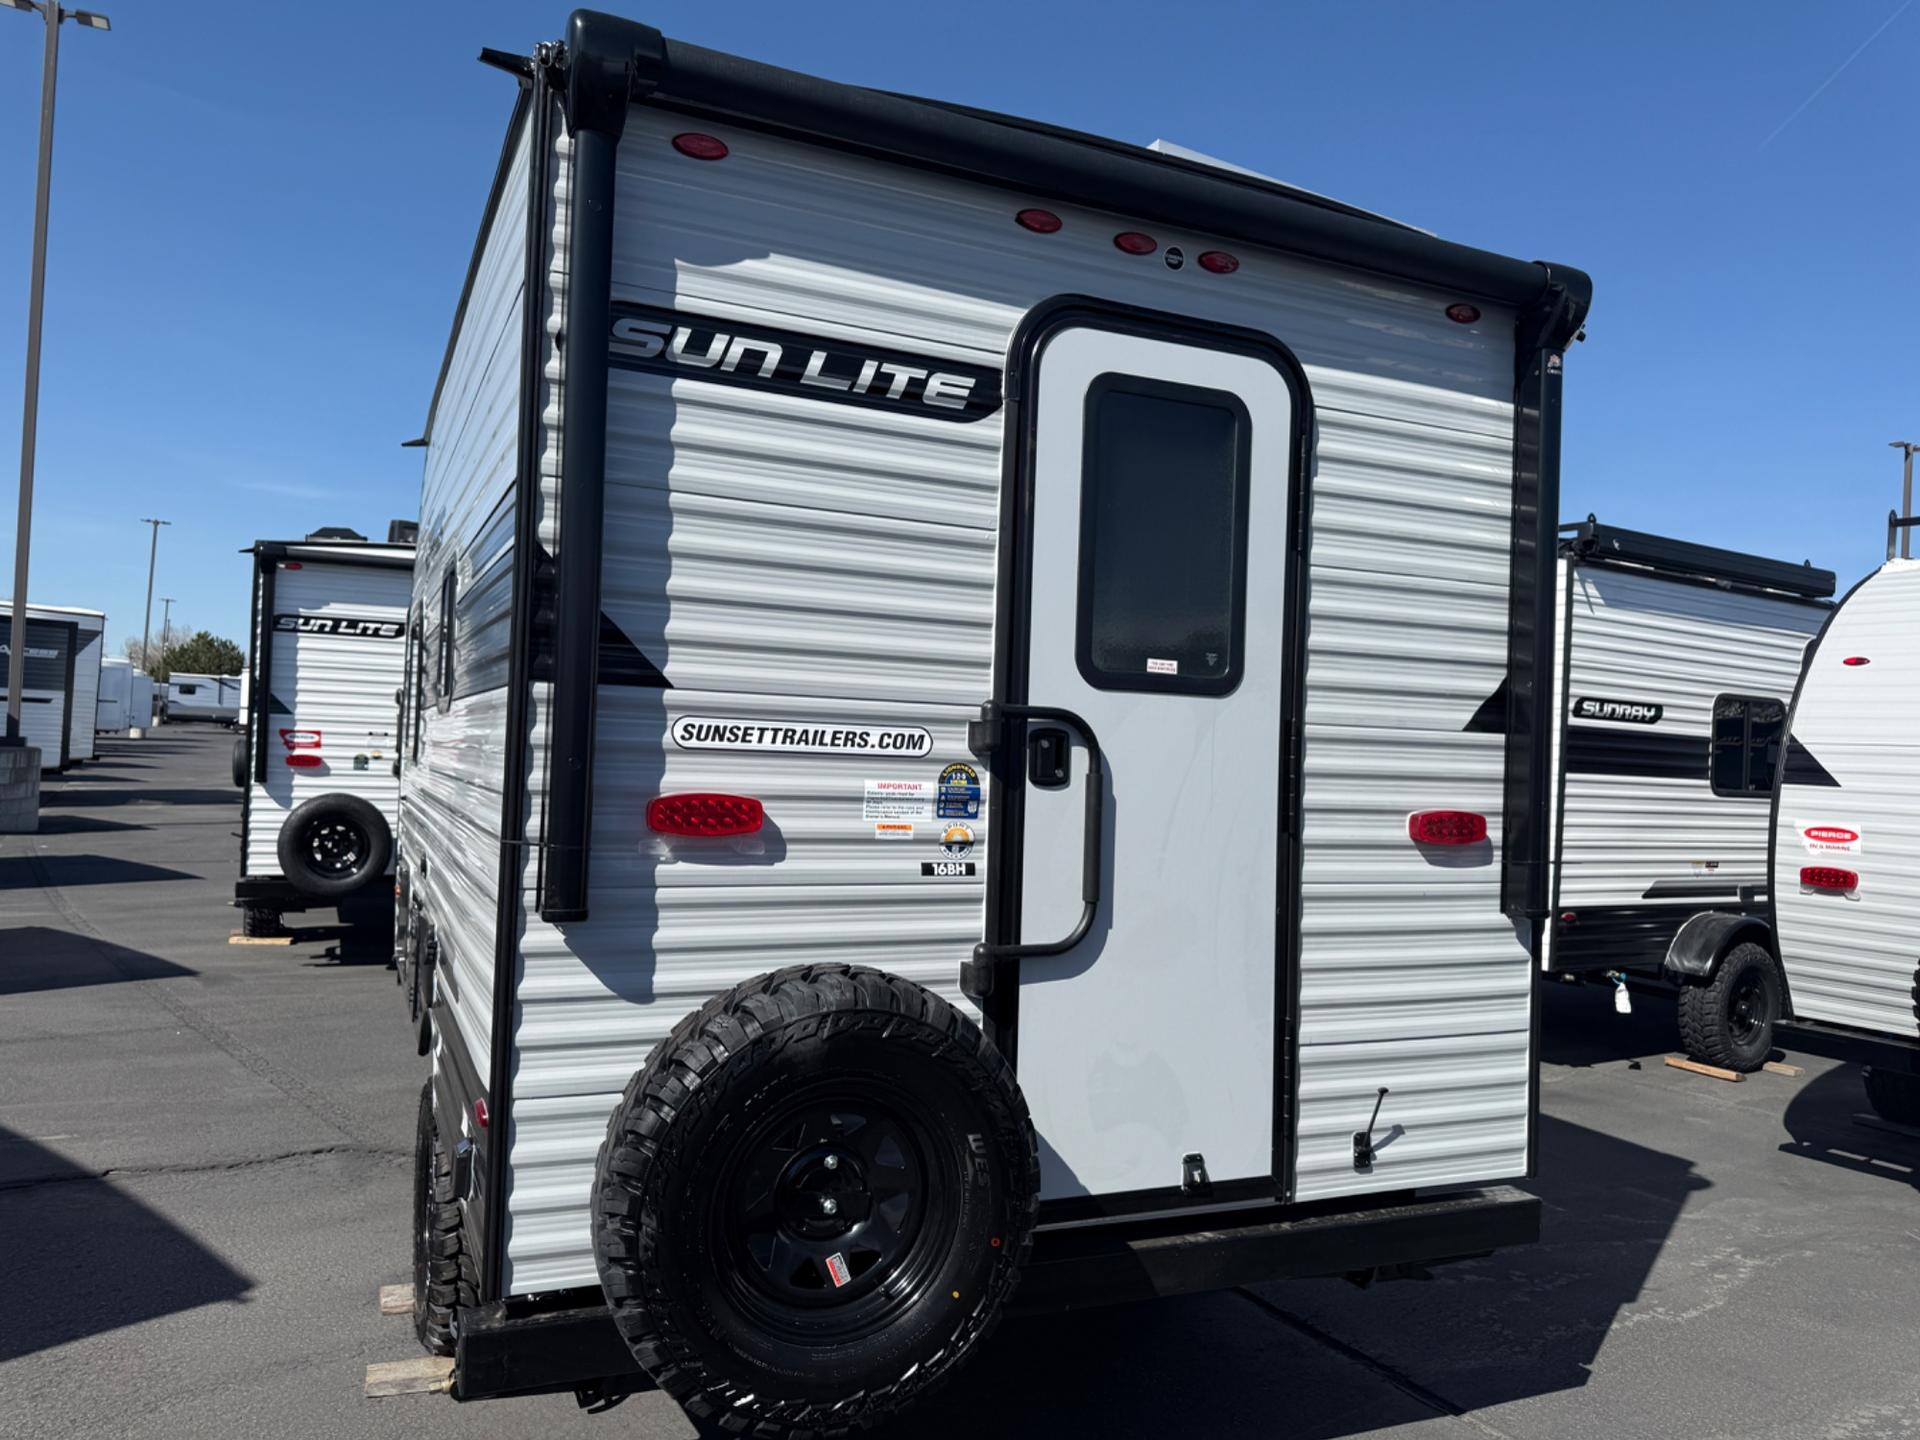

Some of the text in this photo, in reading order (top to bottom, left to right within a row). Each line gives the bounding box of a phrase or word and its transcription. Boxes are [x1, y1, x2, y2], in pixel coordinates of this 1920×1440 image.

[608, 317, 976, 410] SUN LITE
[277, 617, 400, 636] SUN LITE
[1580, 701, 1656, 720] SUNRAY
[680, 723, 925, 750] SUNSETTRAILERS.COM
[877, 783, 922, 791] IMPORTANT
[1810, 830, 1852, 839] PIERCE
[932, 863, 966, 875] 16BH
